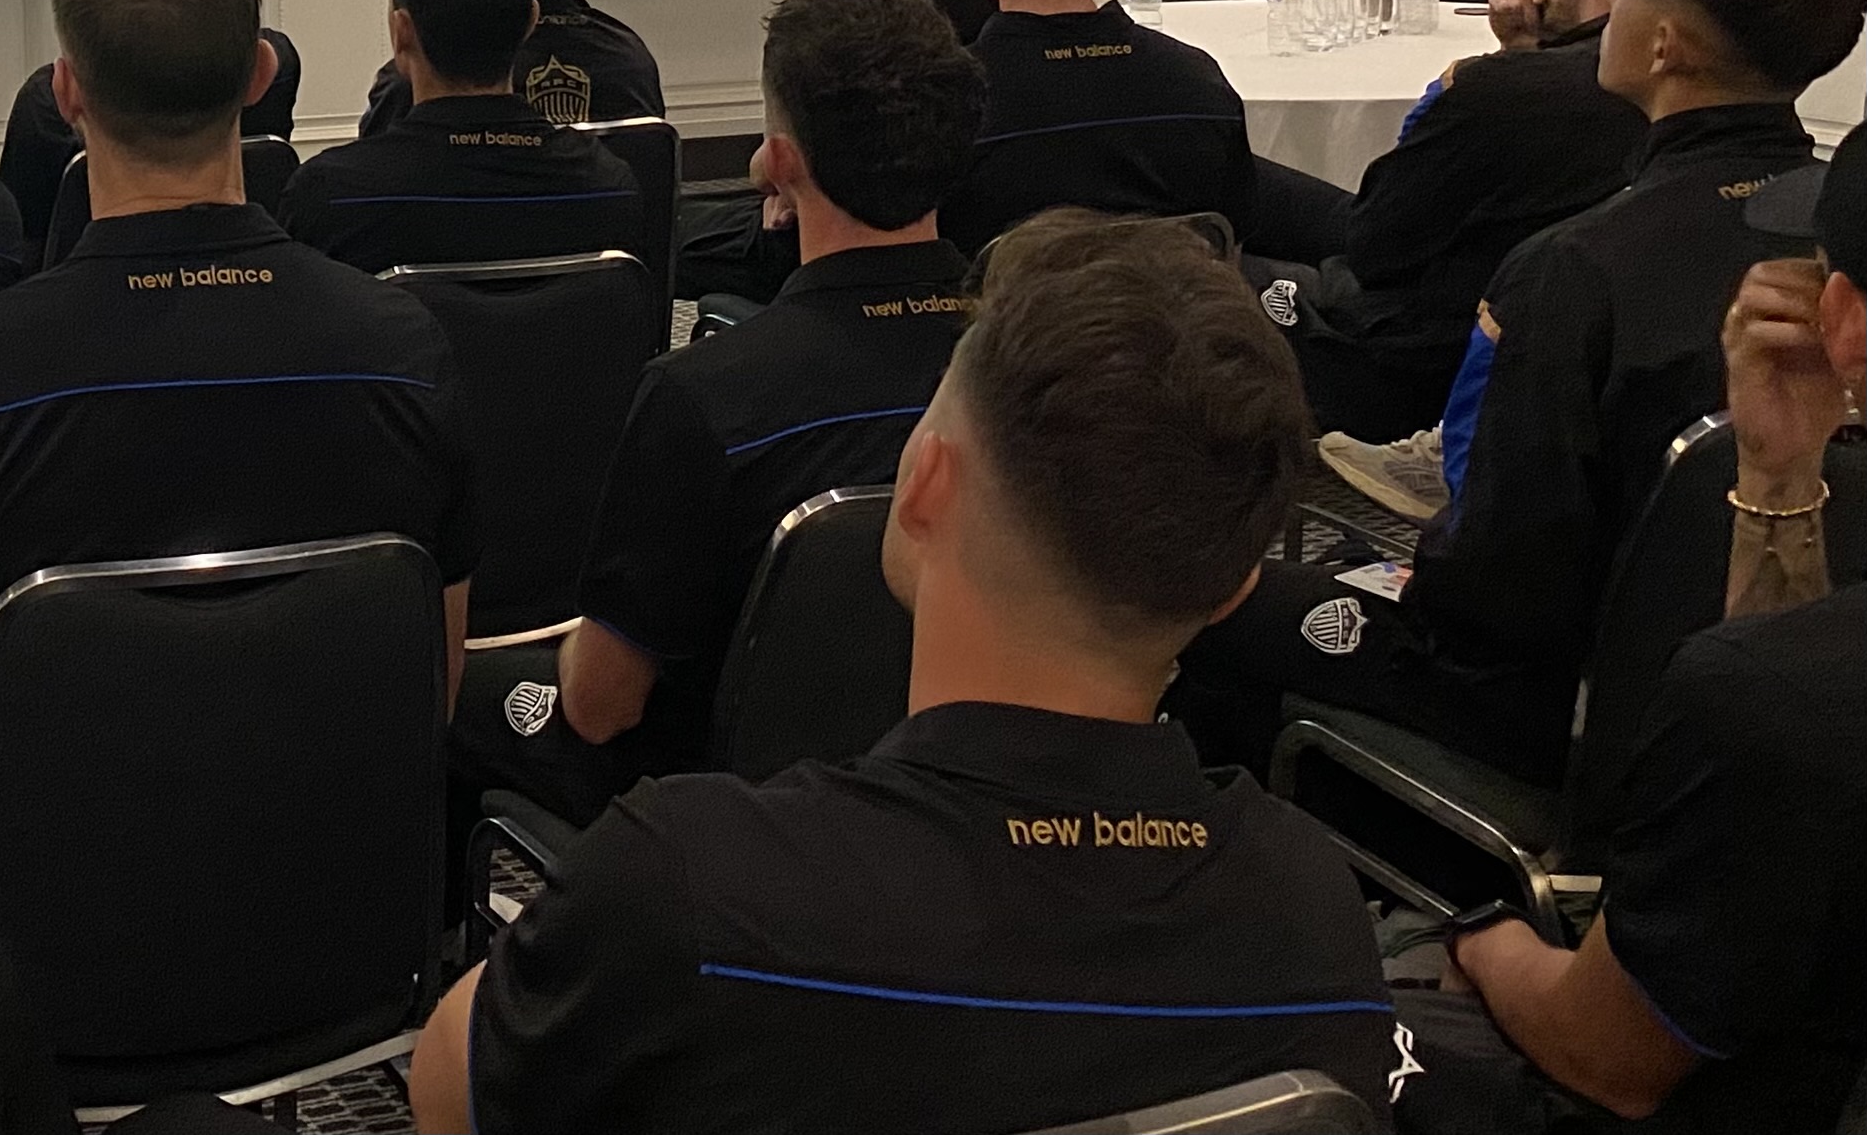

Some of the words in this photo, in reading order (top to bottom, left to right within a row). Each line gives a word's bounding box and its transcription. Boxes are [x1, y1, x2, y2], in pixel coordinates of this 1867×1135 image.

[1045, 46, 1072, 60] new
[1076, 44, 1132, 58] balance
[449, 133, 482, 146] new
[485, 130, 542, 147] balance
[128, 272, 173, 290] new
[181, 264, 273, 287] balance
[861, 300, 903, 318] new
[1006, 816, 1081, 847] new
[1094, 810, 1209, 848] balance
